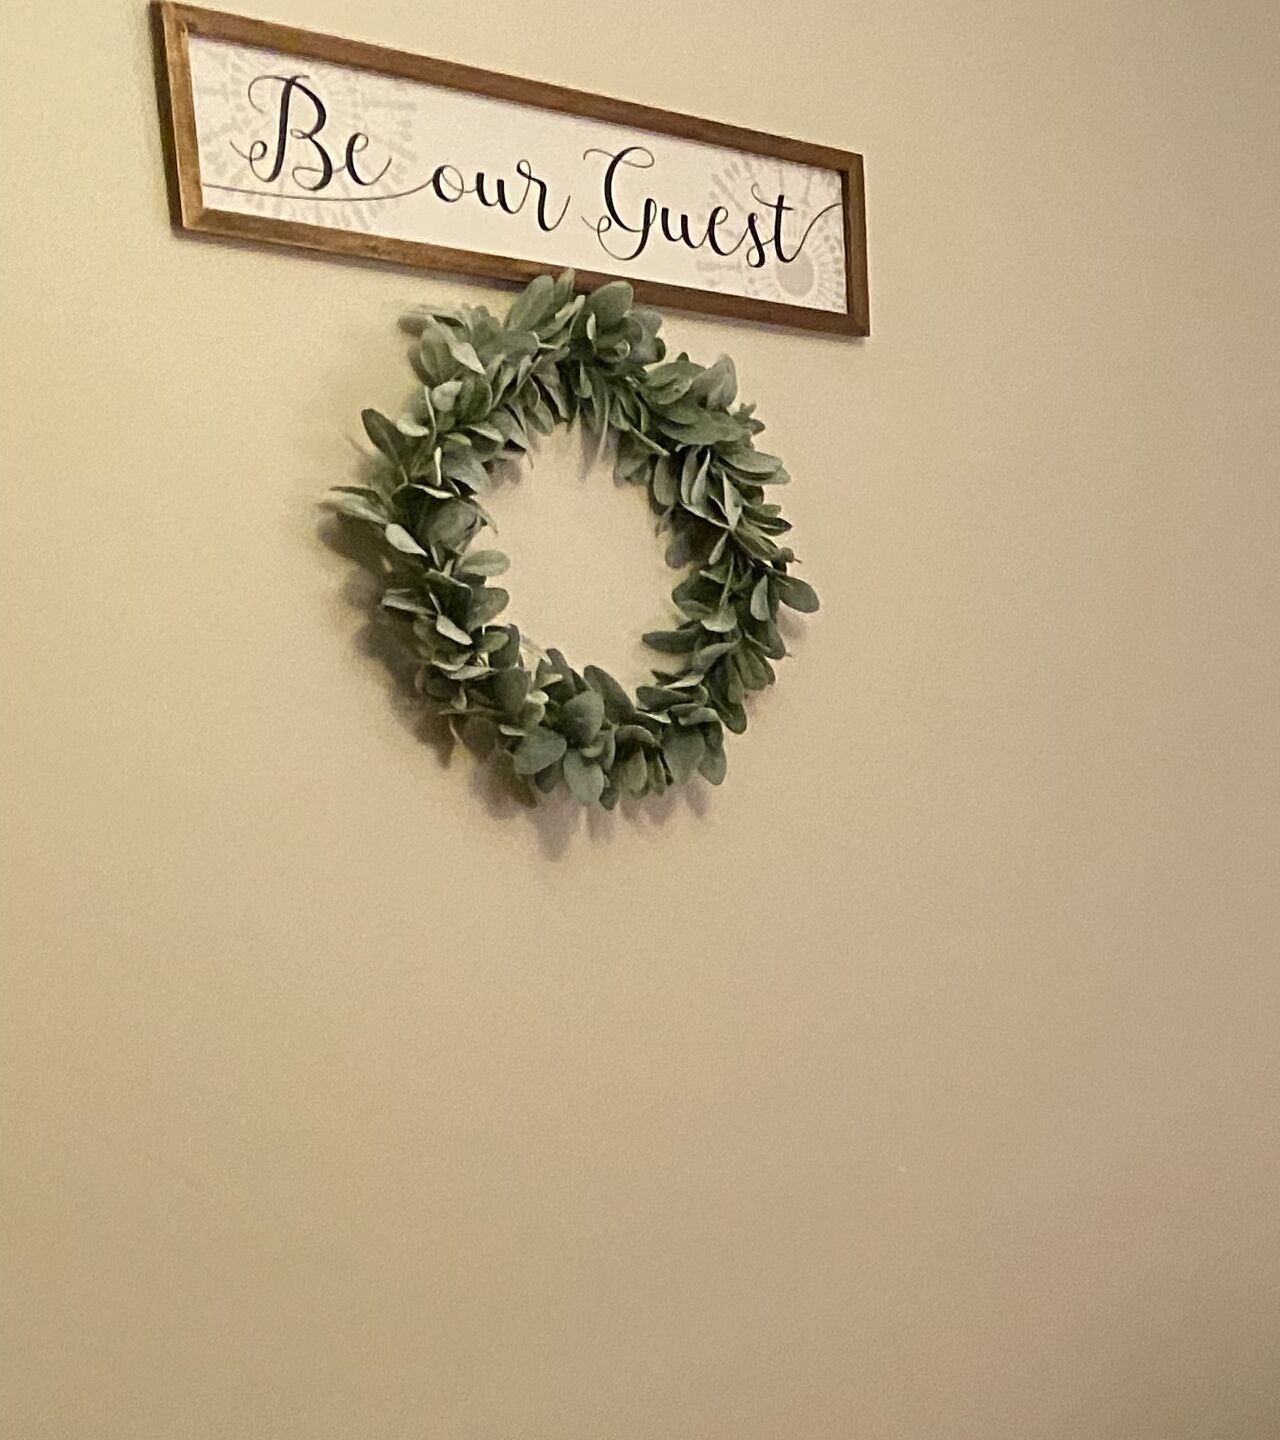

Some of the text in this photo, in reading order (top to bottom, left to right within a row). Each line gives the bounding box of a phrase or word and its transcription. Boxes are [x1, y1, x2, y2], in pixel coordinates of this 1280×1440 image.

[230, 74, 842, 268] Be our Guest
